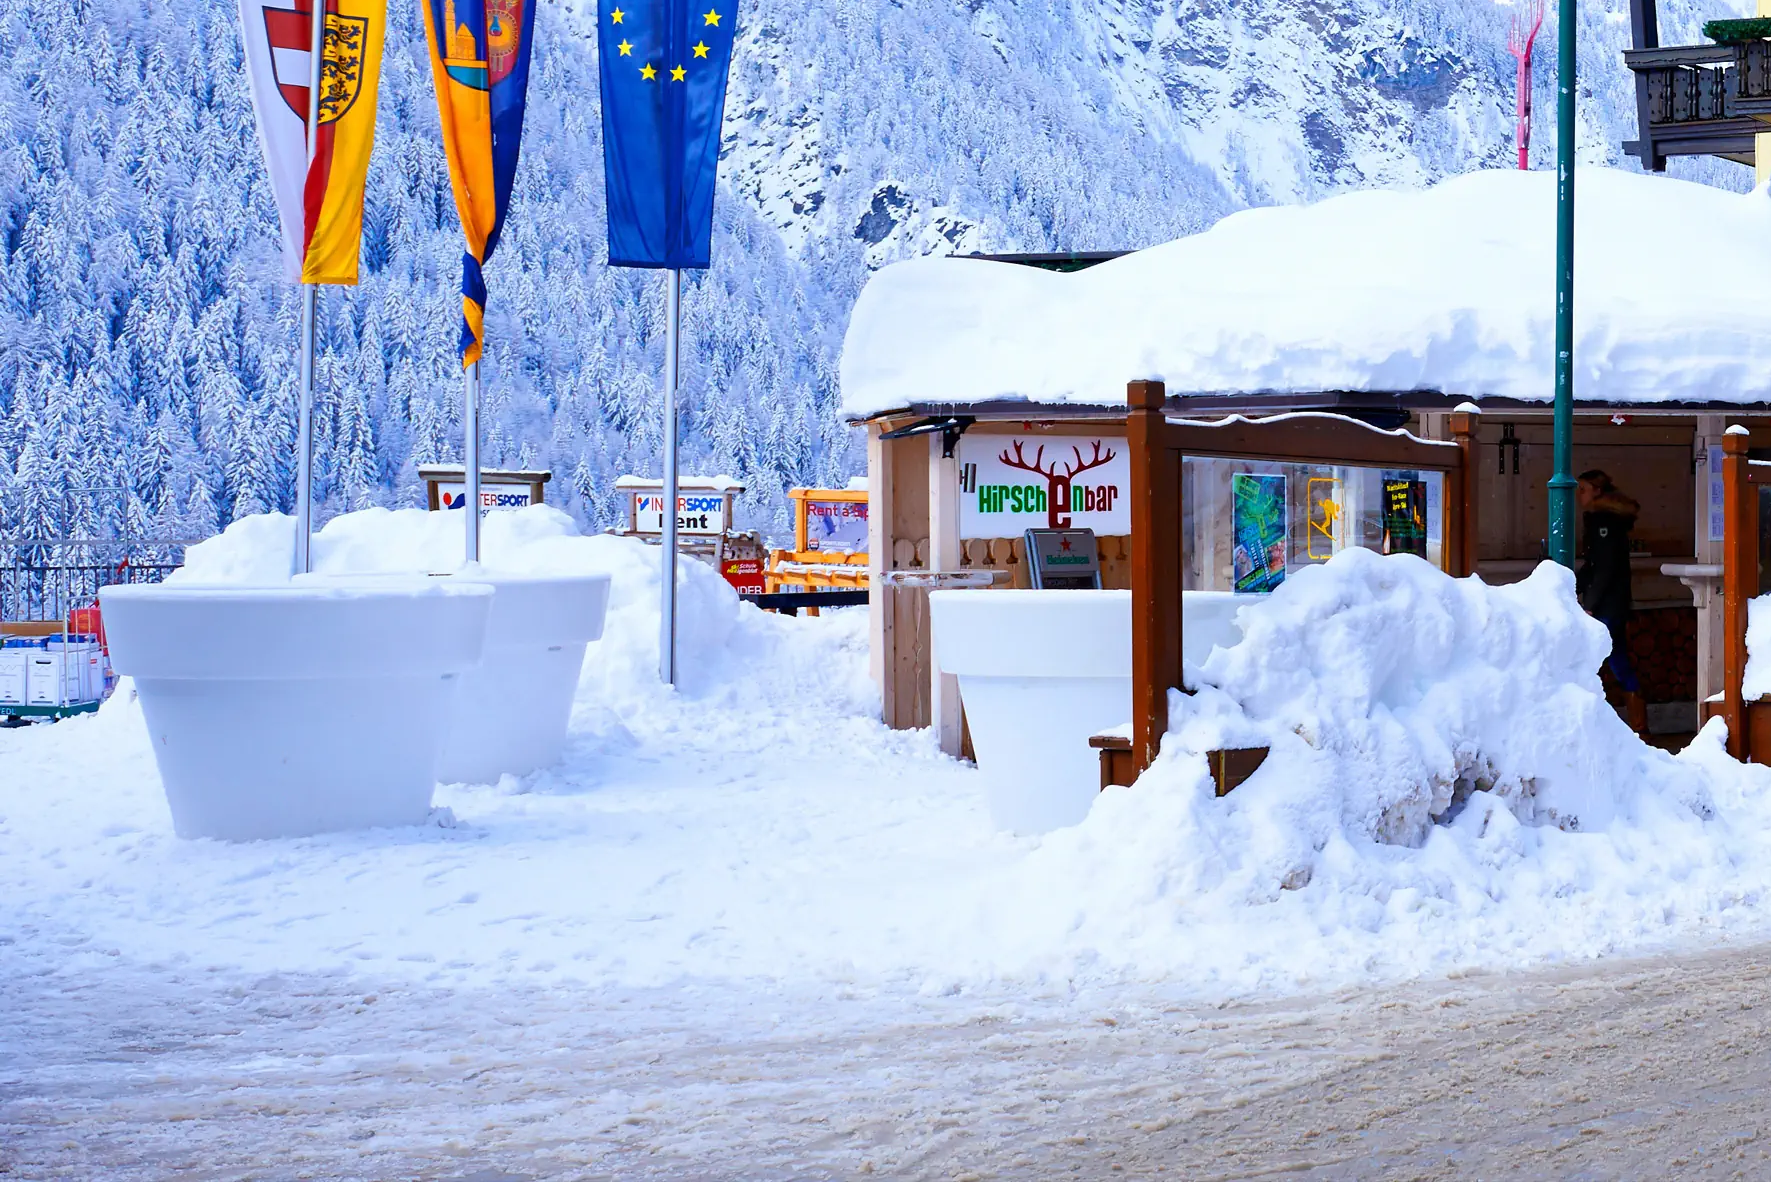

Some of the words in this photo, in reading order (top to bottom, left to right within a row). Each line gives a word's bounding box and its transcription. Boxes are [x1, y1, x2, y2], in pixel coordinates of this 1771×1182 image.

[479, 493, 529, 507] TERSPORT
[651, 497, 723, 512] INRSPORT
[978, 475, 1118, 528] Hirschenbar
[807, 503, 838, 517] Rent
[842, 507, 850, 517] a
